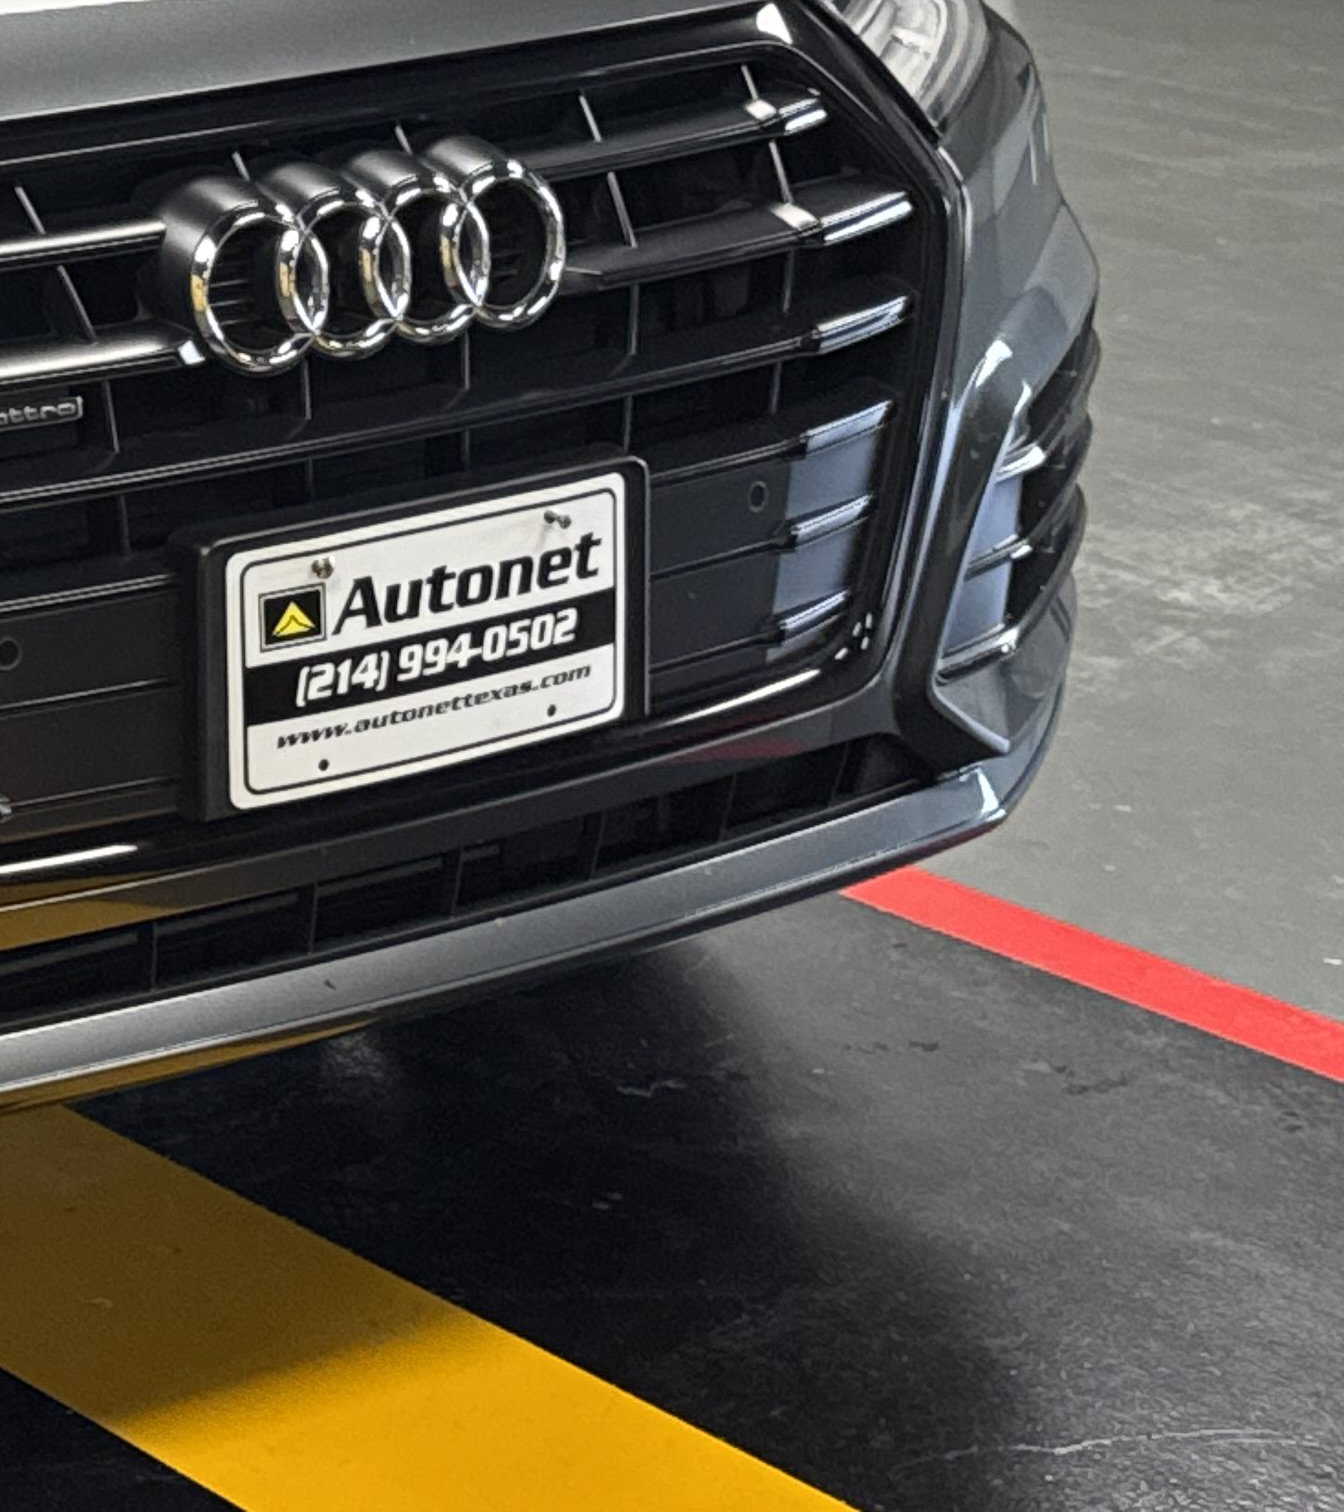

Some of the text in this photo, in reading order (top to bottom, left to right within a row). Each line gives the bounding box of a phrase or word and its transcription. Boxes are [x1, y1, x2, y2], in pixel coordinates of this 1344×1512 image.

[332, 531, 602, 635] Autonet
[276, 664, 592, 750] www.autonettexas.com
[295, 607, 578, 708] (214) 994-0502
